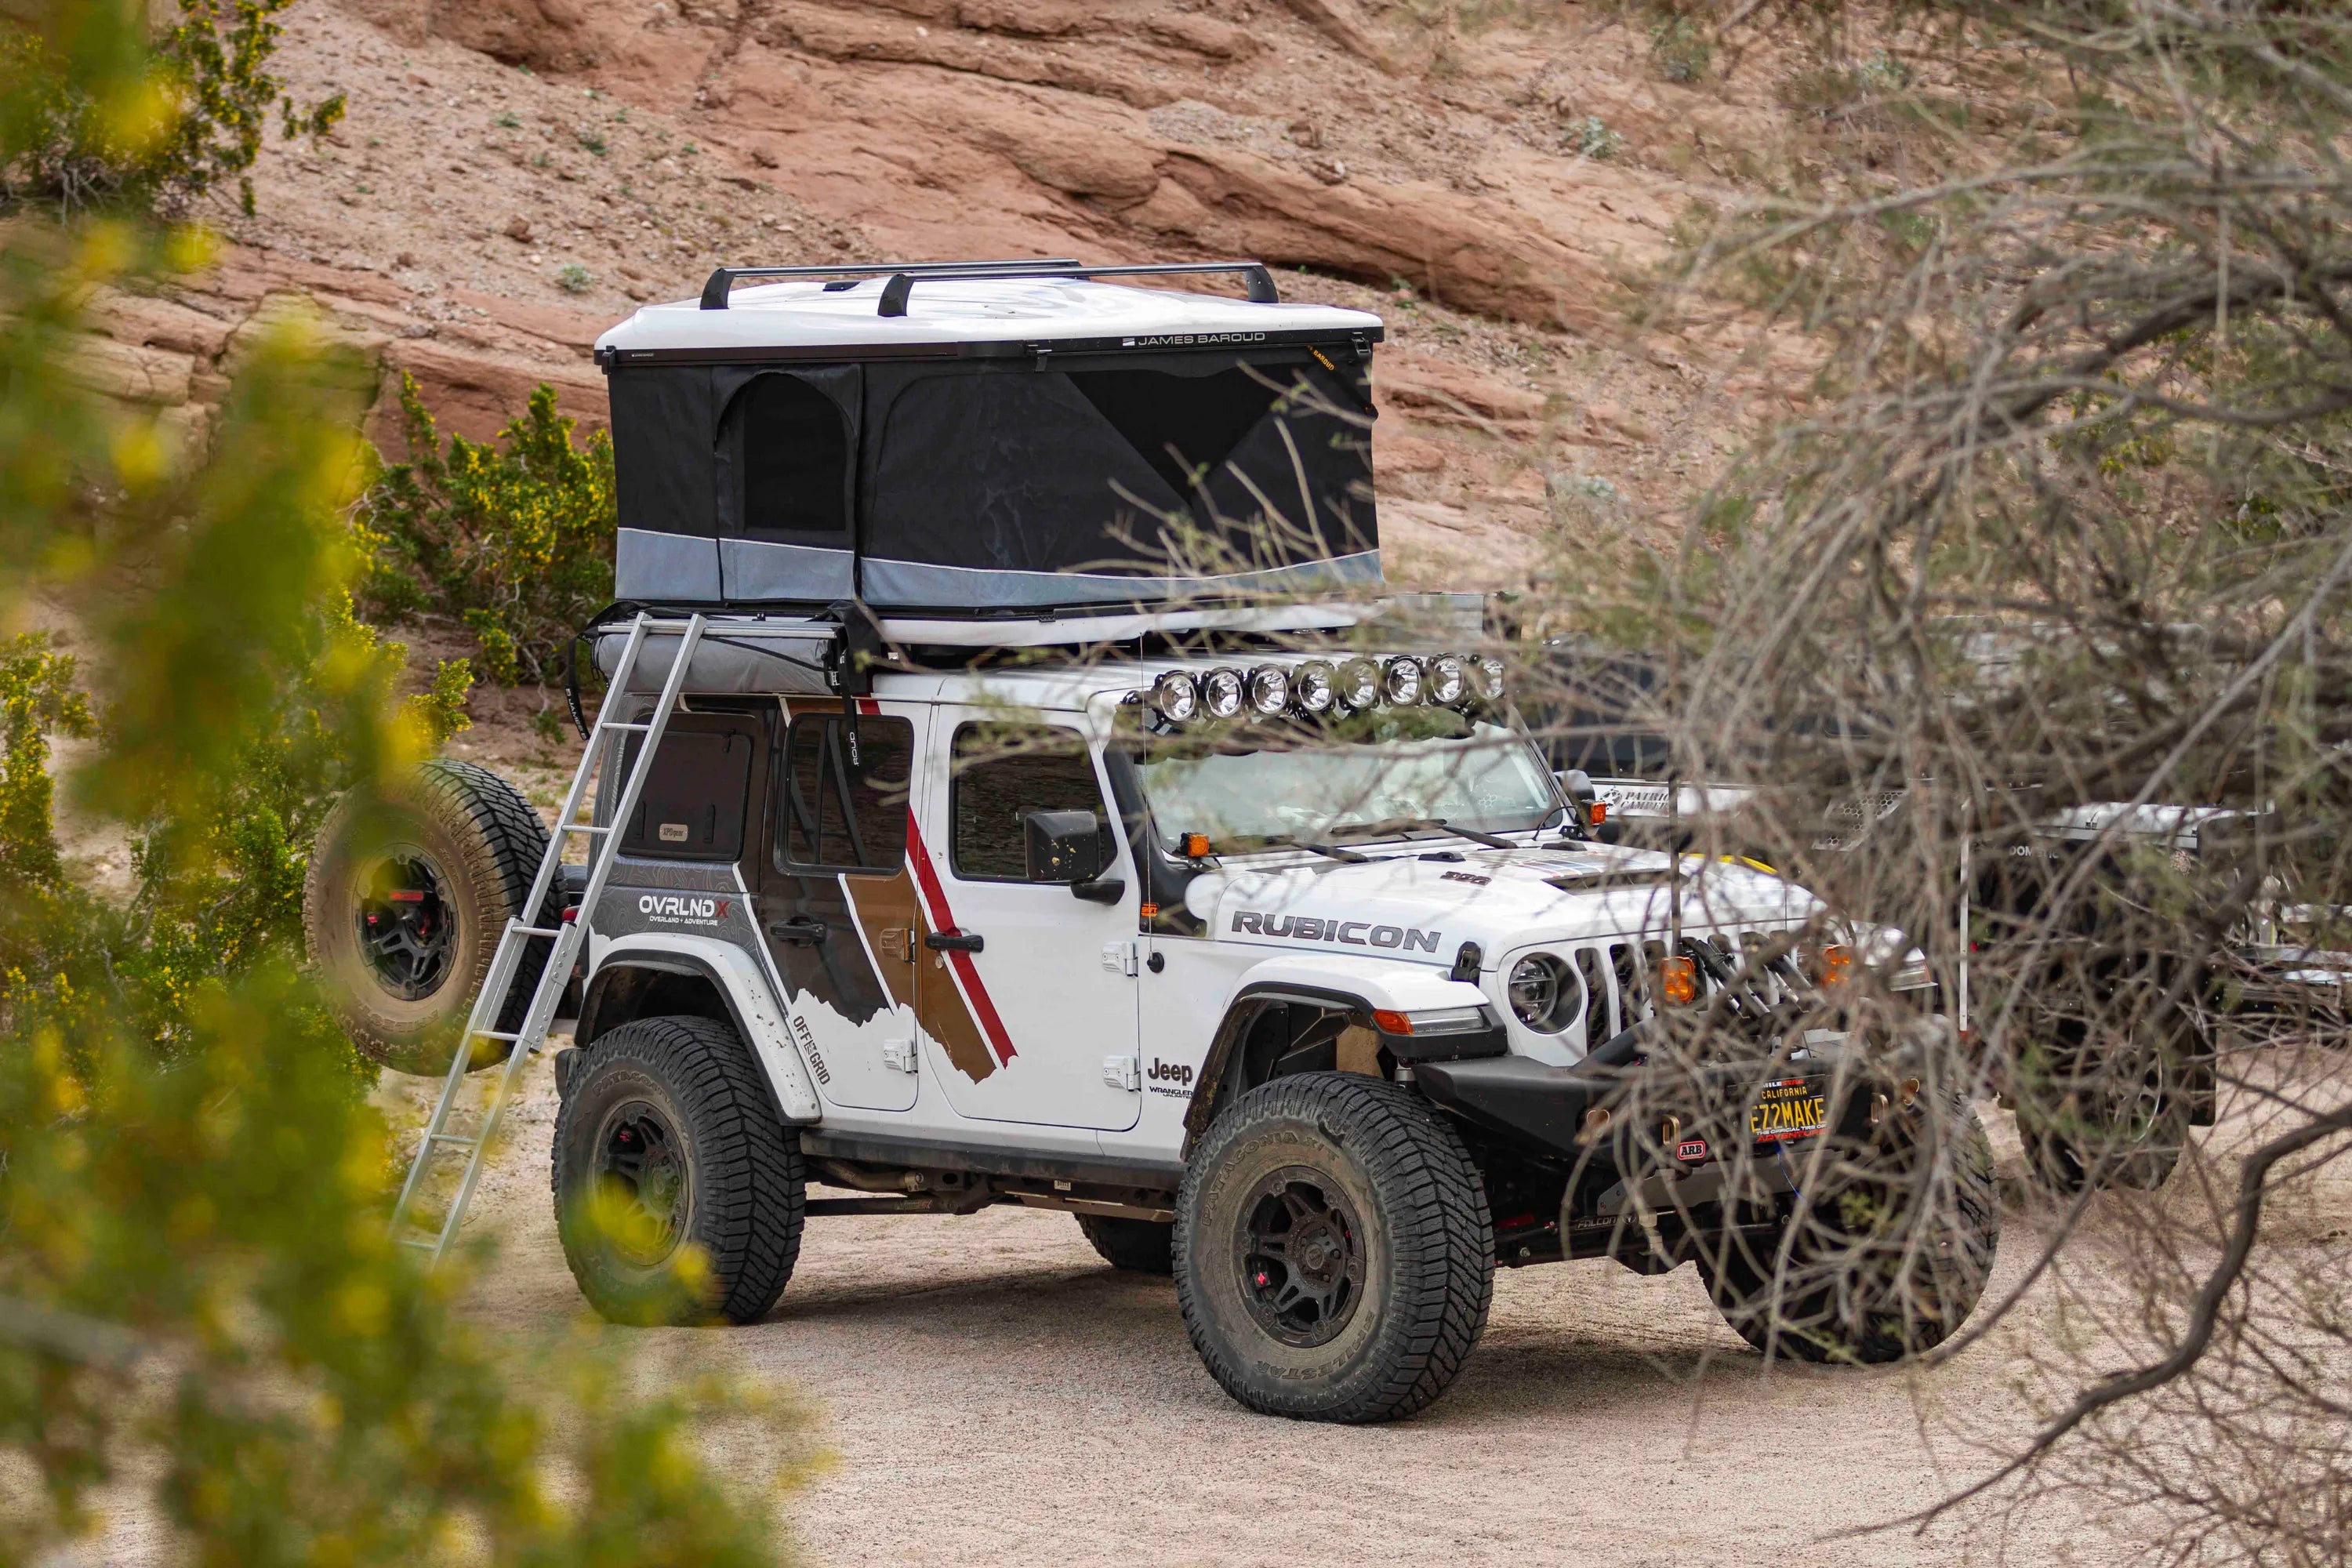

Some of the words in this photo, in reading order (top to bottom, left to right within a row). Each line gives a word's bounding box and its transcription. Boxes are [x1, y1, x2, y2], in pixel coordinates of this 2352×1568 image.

[1138, 336, 1193, 346] JAMES
[1197, 332, 1265, 343] BAROUD
[1313, 350, 1334, 371] BAROUD
[568, 699, 584, 732] JAMES
[1624, 791, 1670, 801] PATRIO
[2009, 845, 2059, 858] DOMIC
[1232, 911, 1441, 953] RUBICON
[1148, 1058, 1193, 1086] Jeep
[1149, 1086, 1194, 1096] WRANGLER
[1761, 1086, 1808, 1099] CALIFORNIA
[1749, 1098, 1828, 1133] EZ2MAKE
[1681, 1145, 1703, 1156] ARB
[1201, 1131, 1298, 1227] PATAGONIA
